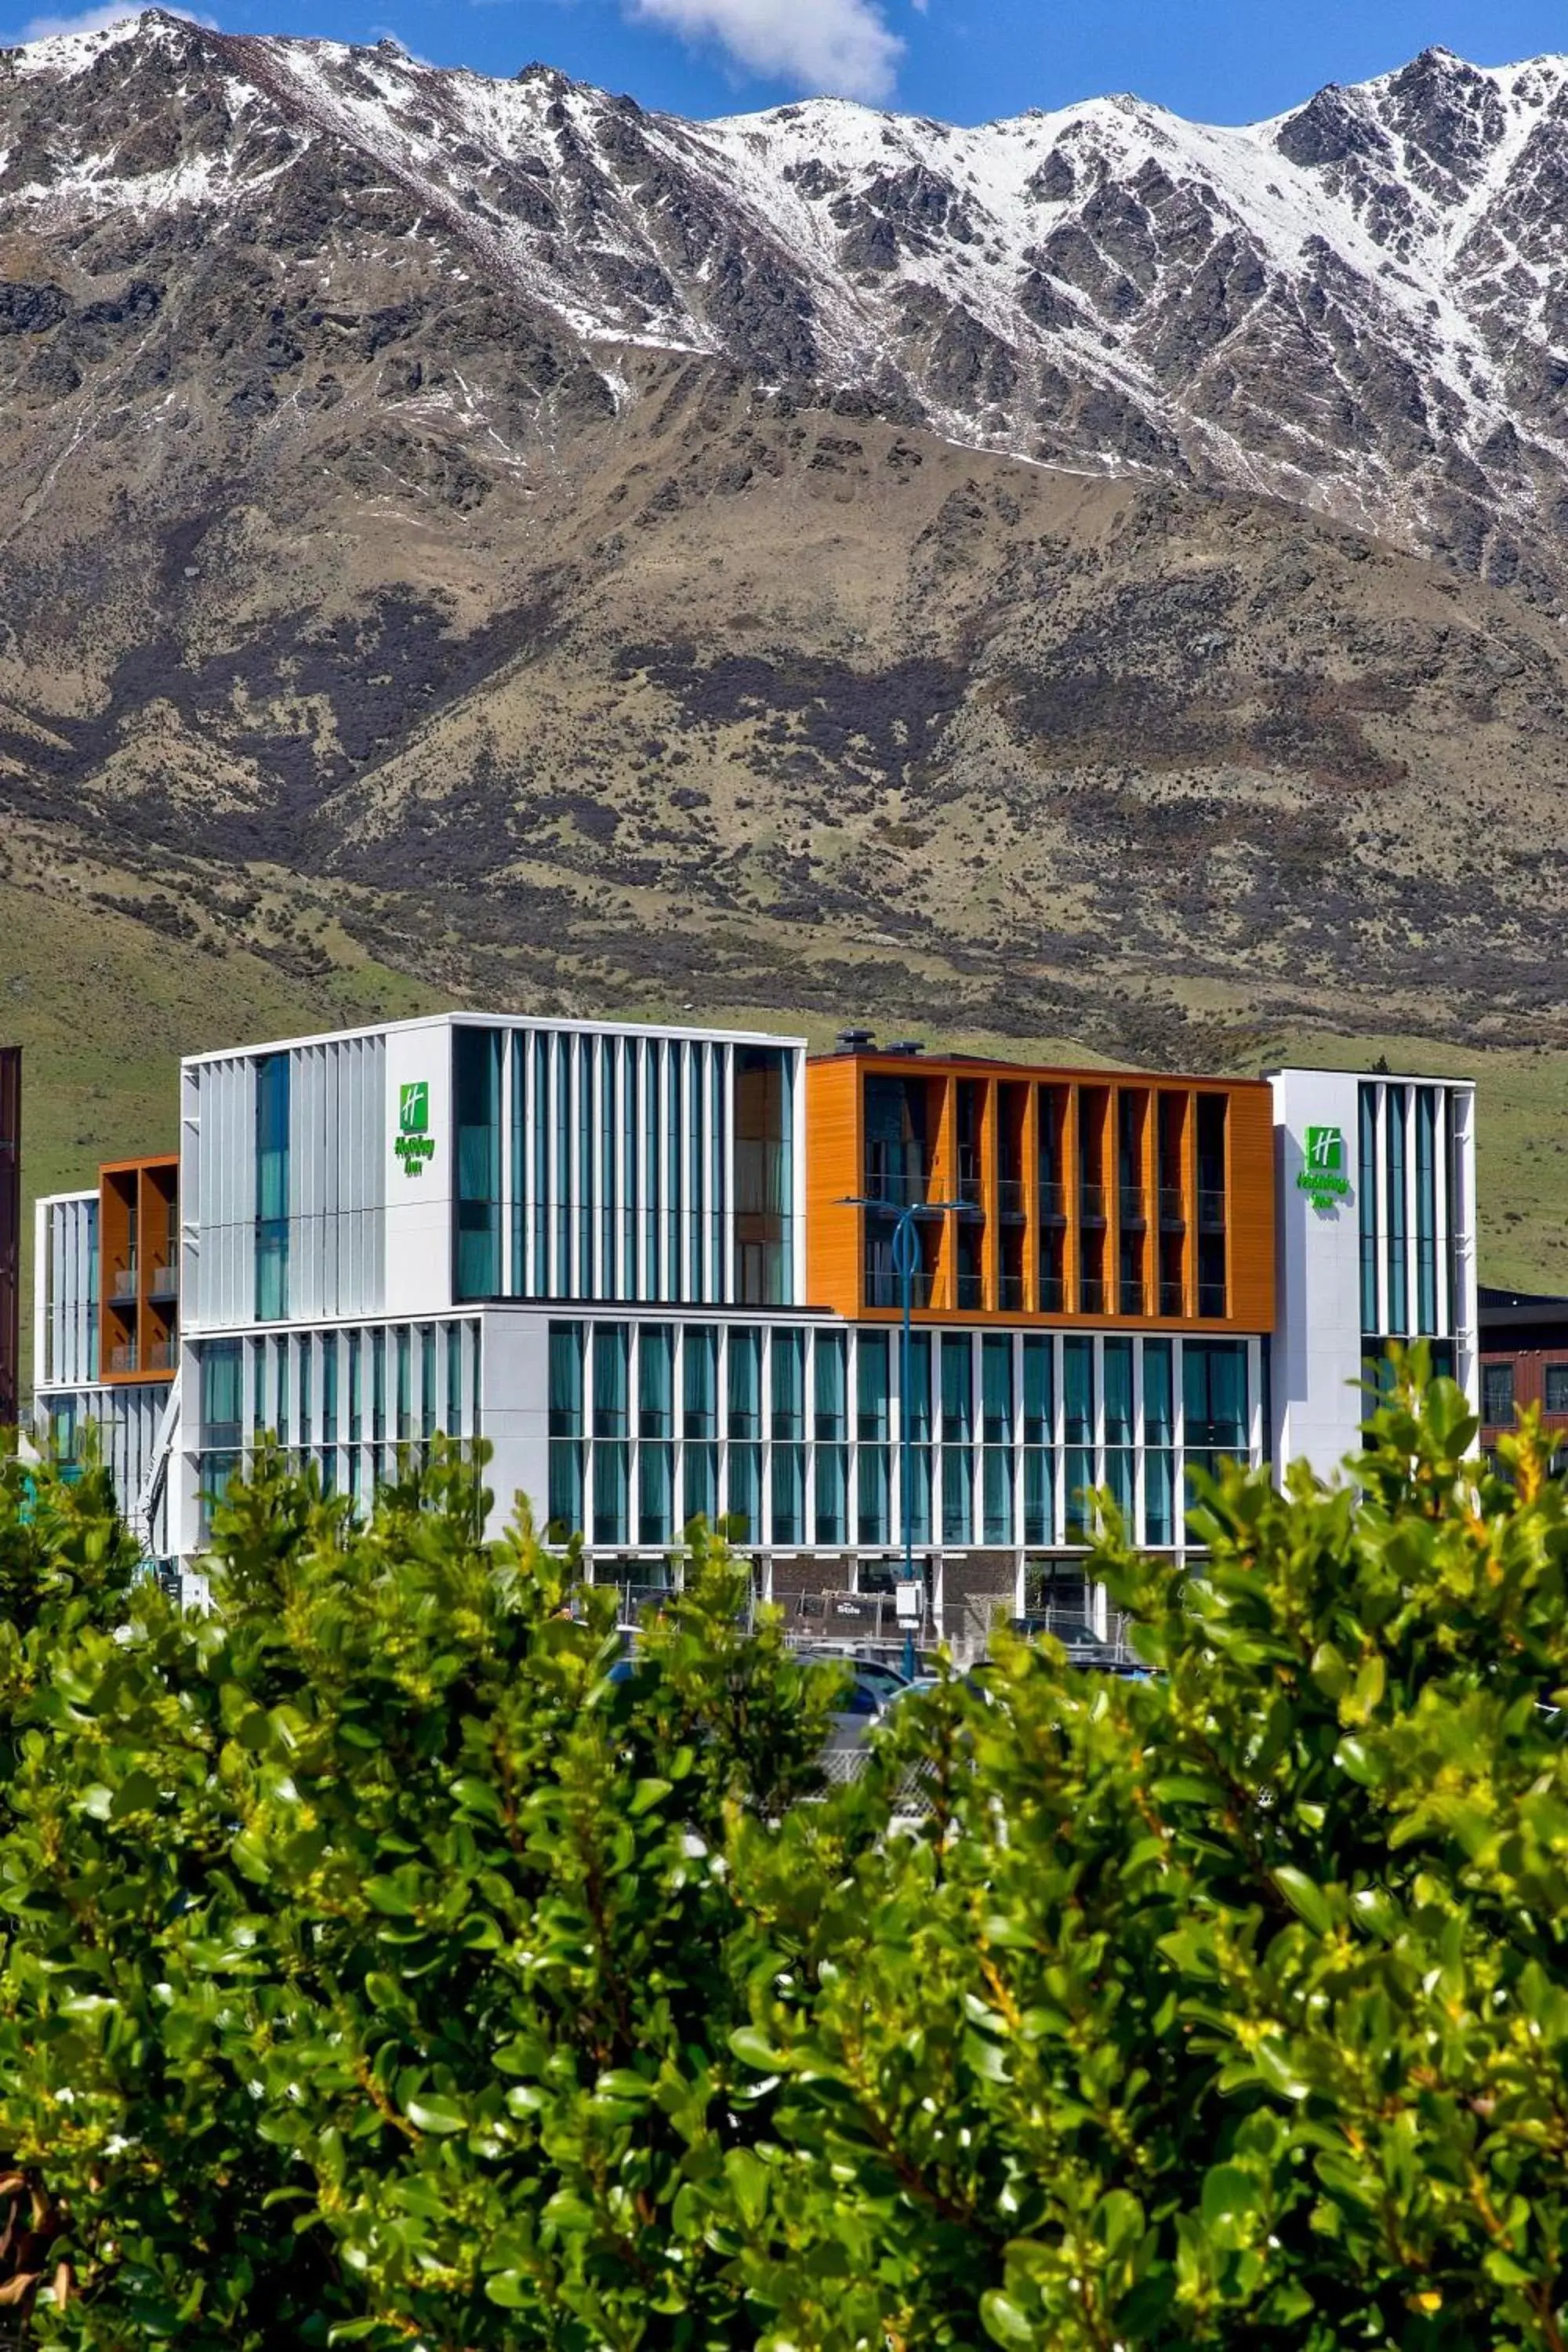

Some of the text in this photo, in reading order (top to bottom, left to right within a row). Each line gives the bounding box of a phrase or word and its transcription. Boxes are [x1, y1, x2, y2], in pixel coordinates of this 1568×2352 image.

[402, 1084, 424, 1126] H
[394, 1135, 434, 1160] Holiday
[1310, 1130, 1341, 1166] H
